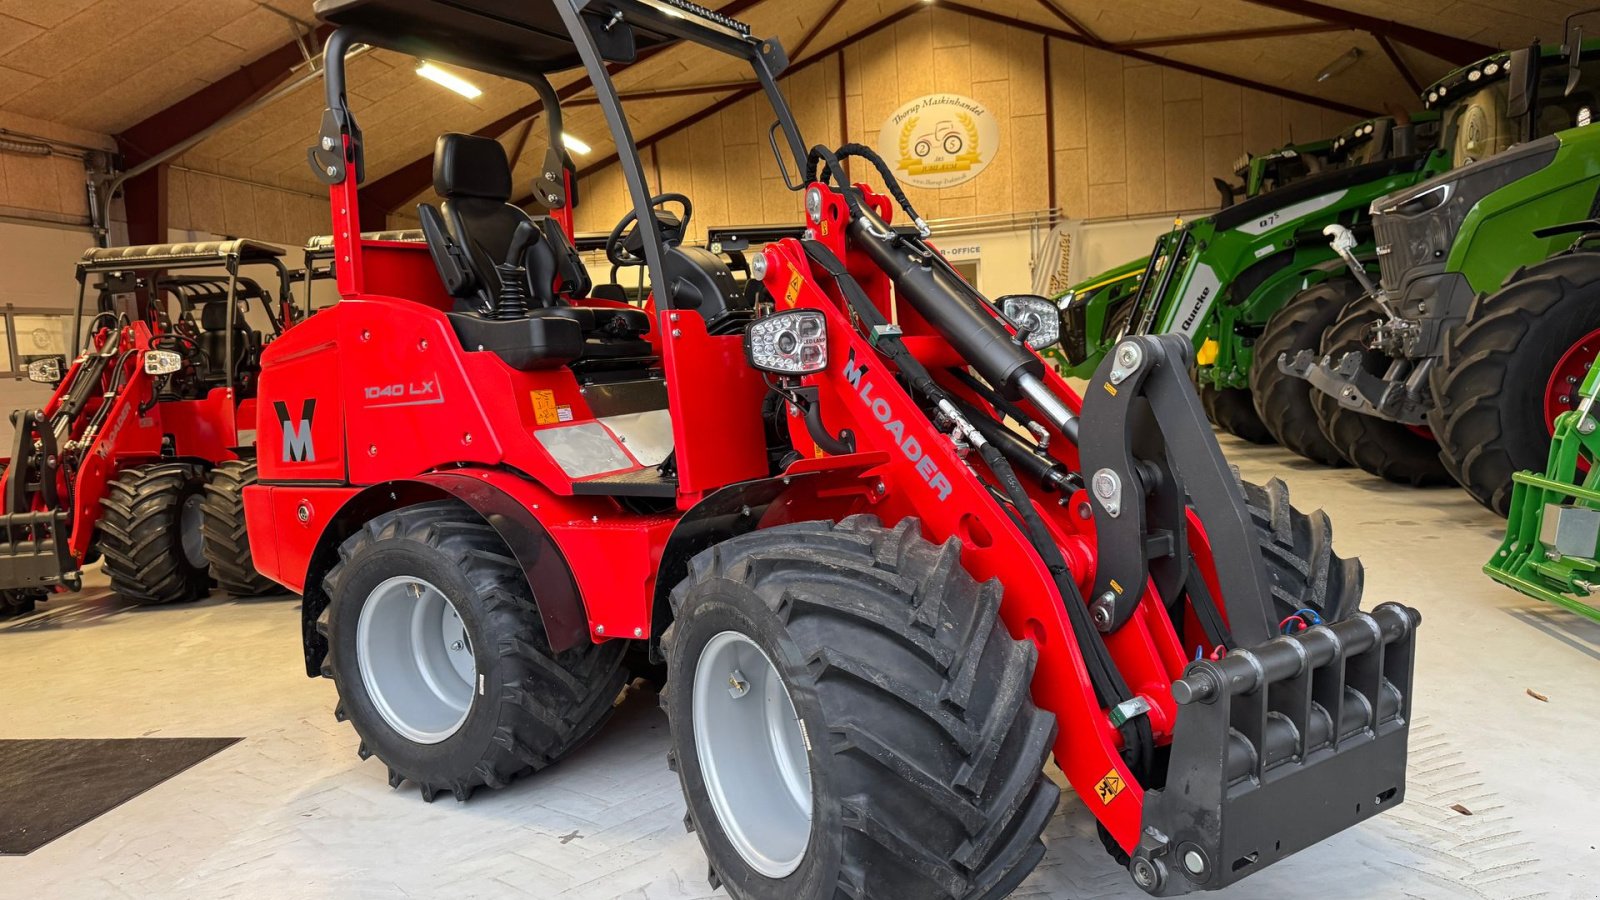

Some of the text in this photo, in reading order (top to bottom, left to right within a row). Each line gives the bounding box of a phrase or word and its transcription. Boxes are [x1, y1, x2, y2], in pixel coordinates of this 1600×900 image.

[892, 96, 985, 125] Thorup Maskinhandel
[951, 246, 981, 255] OFFICE
[1182, 287, 1210, 331] Quicke
[364, 381, 434, 399] 1040 LX
[859, 382, 953, 502] LOADER
